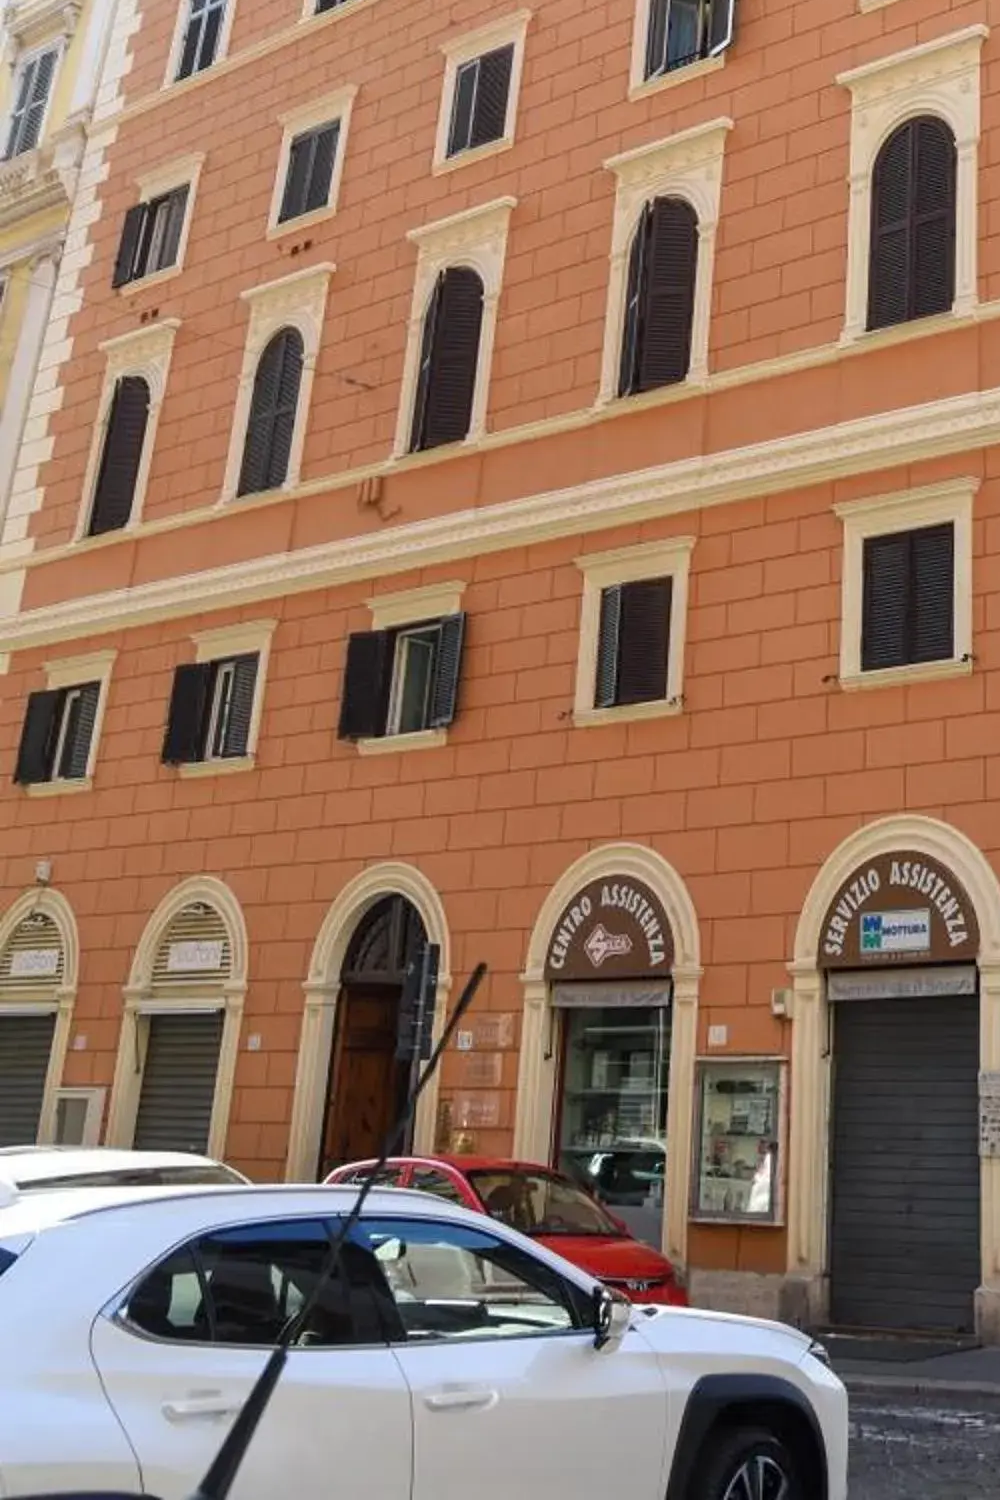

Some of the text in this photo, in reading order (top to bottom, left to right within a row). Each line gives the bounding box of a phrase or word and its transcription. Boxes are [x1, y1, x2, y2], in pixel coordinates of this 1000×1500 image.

[549, 884, 666, 969] CENTRO ASSISTENZA
[824, 861, 969, 956] SERVIZIO ASSISTENZA
[881, 922, 927, 936] MOTTURA
